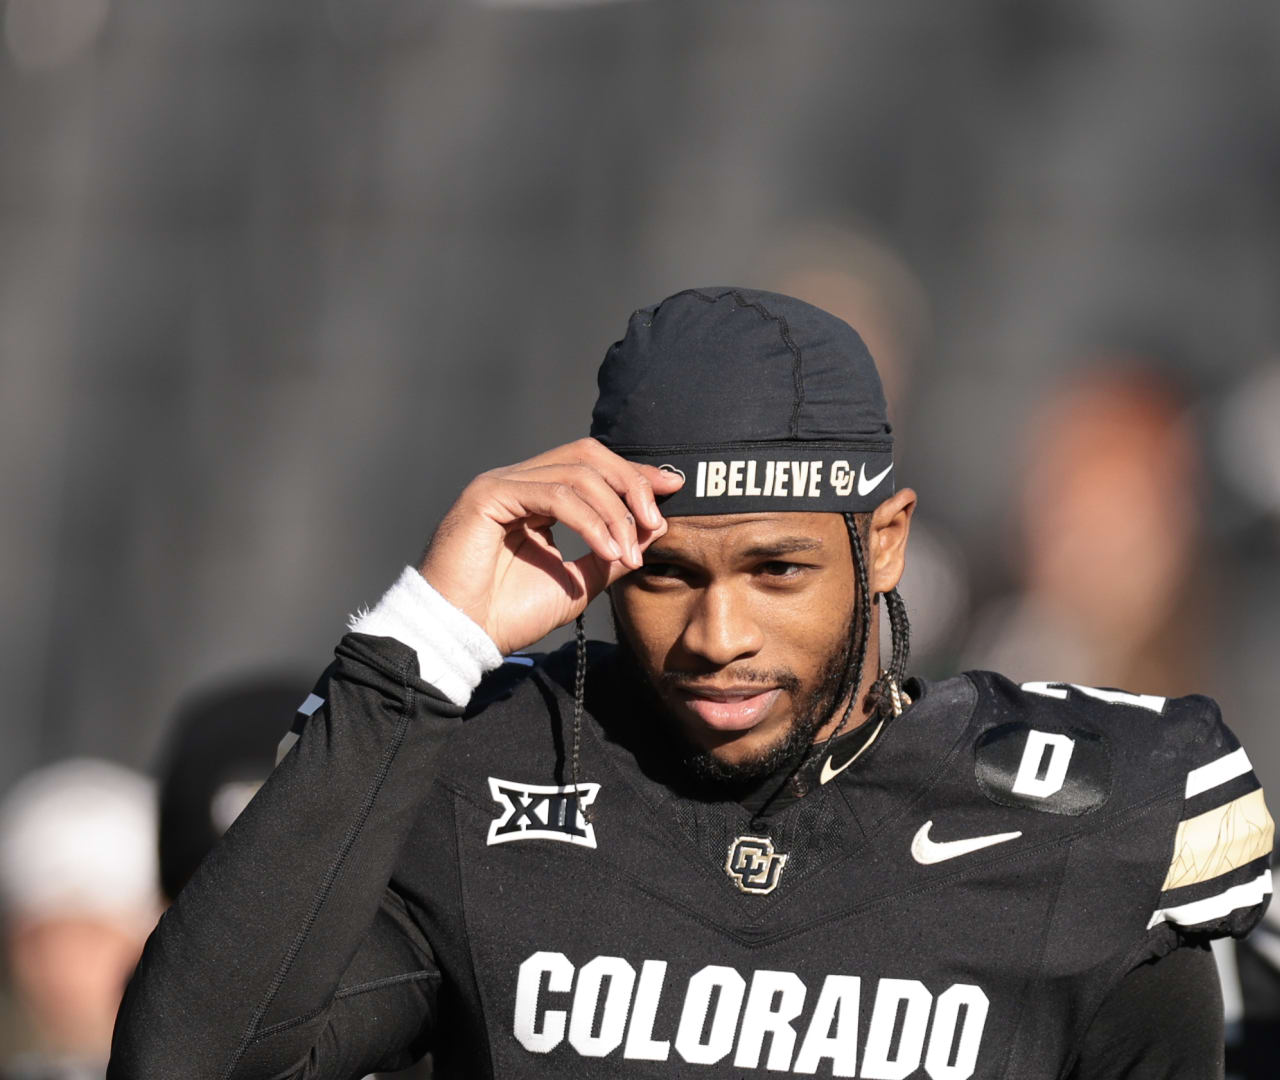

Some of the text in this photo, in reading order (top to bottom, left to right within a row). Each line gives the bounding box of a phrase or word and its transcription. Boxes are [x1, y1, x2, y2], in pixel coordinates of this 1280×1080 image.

[829, 460, 855, 496] CU
[1011, 729, 1075, 799] D
[494, 783, 592, 839] XII
[725, 836, 789, 894] CU
